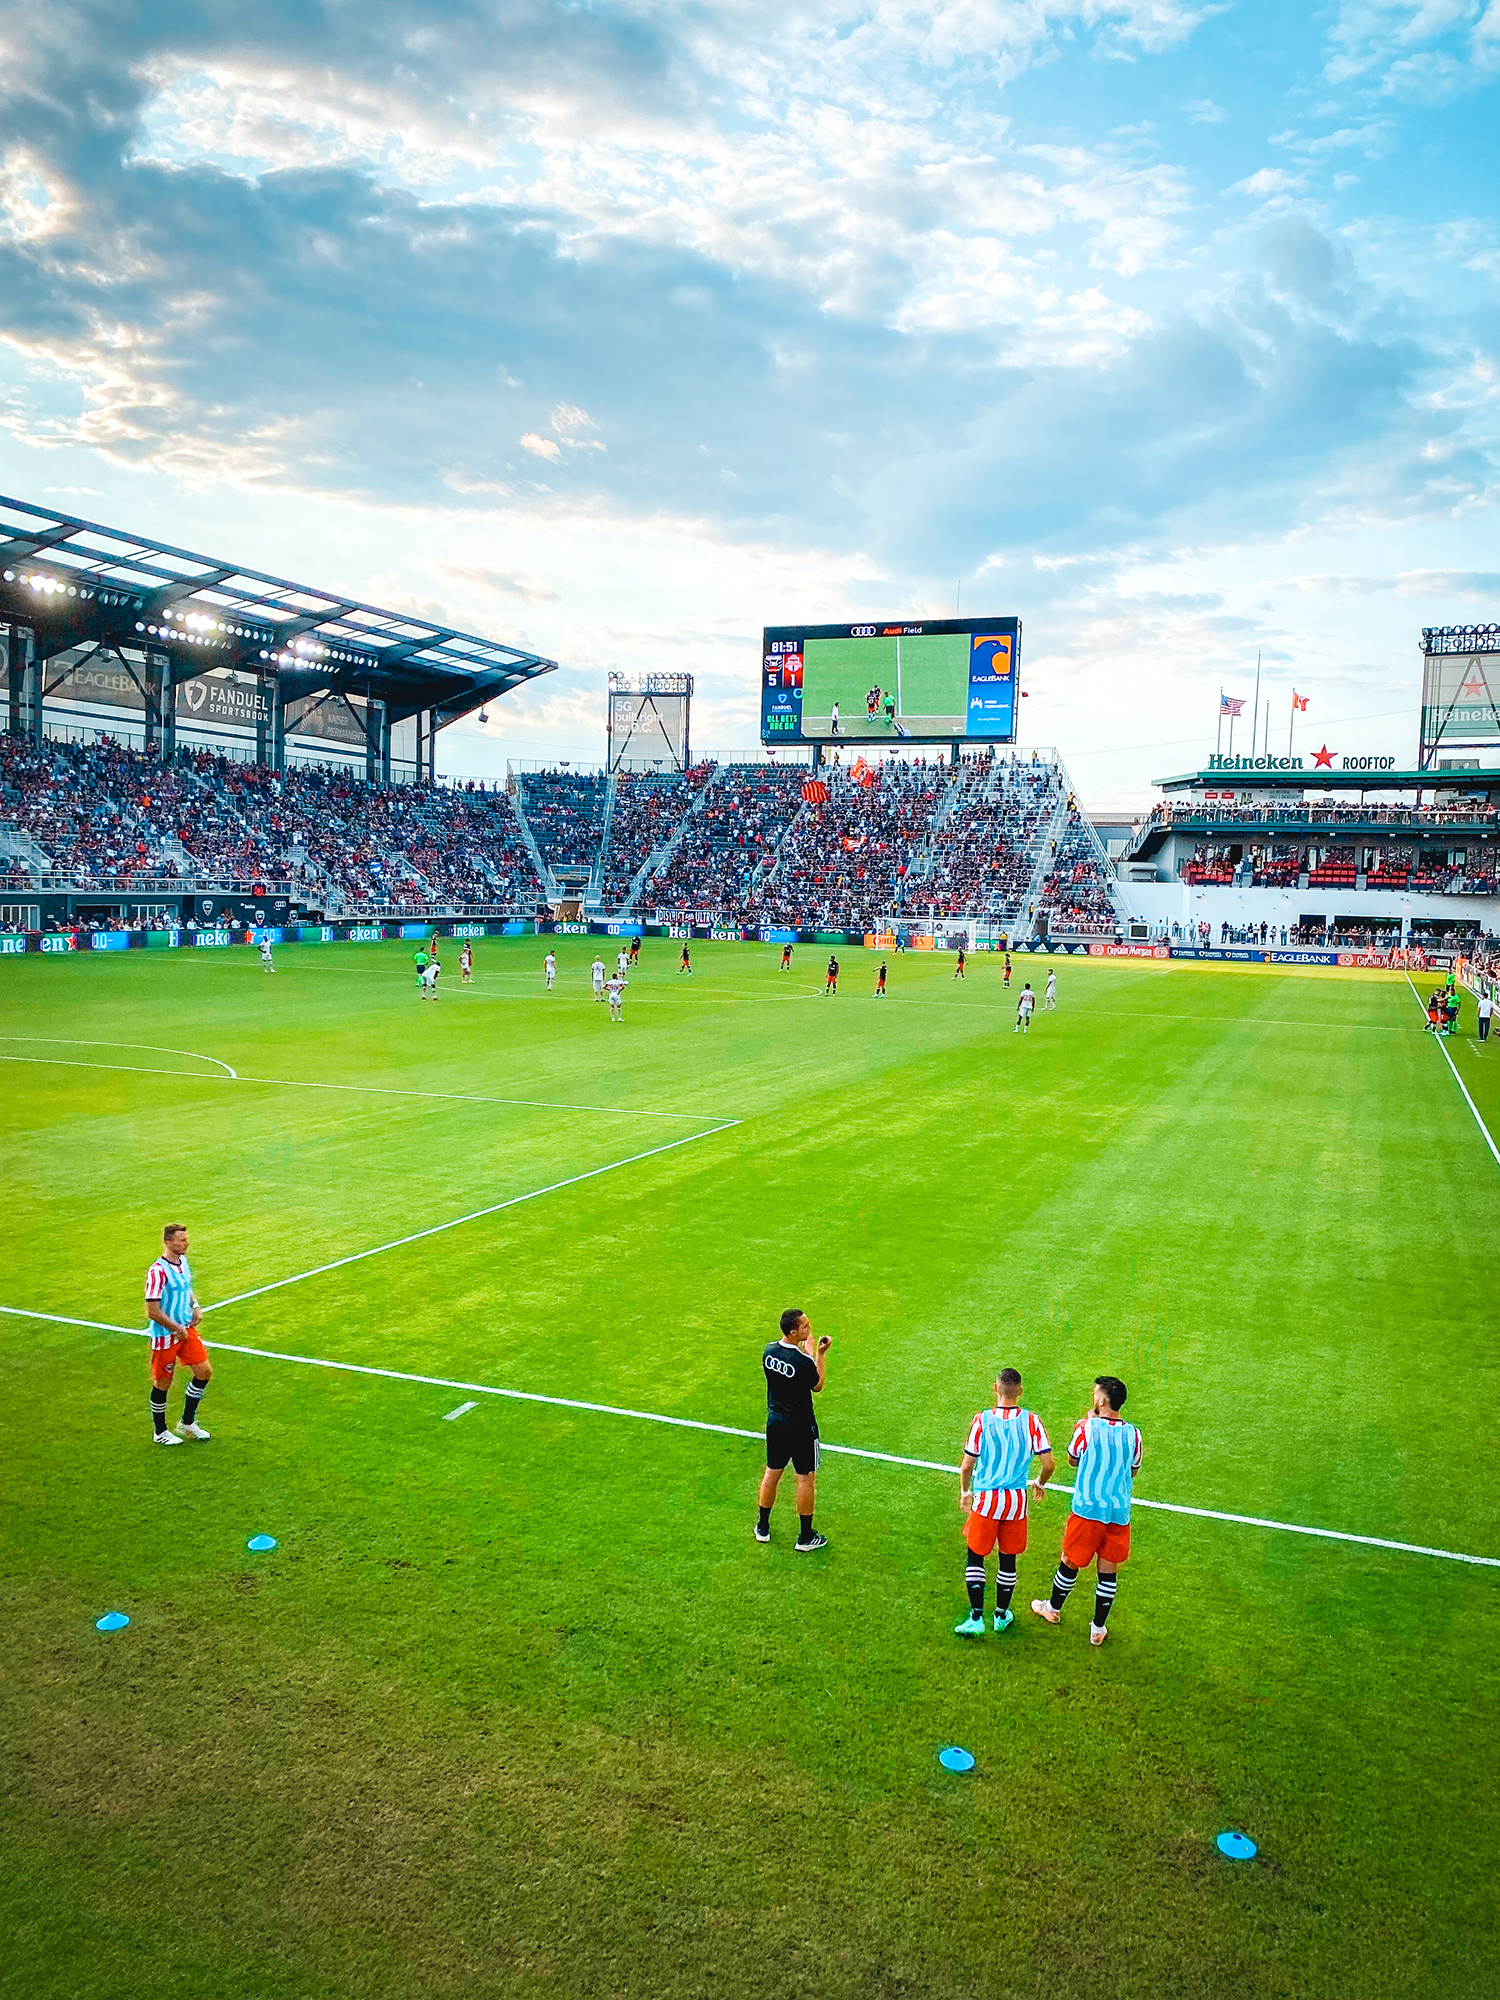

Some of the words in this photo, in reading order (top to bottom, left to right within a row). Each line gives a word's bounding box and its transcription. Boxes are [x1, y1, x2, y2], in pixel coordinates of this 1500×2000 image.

[883, 627, 902, 635] Audi
[903, 626, 922, 634] Field
[771, 641, 797, 653] 81:51
[768, 673, 777, 686] 5
[790, 673, 796, 686] 1
[210, 686, 269, 711] FANDUEL
[209, 703, 269, 722] SPORTSBOOK
[614, 701, 632, 711] 5G
[614, 722, 629, 733] for
[1208, 753, 1304, 770] Heineken
[1342, 756, 1396, 770] ROOFTOP
[1107, 945, 1129, 956] Captain
[1128, 946, 1153, 957] Morgan
